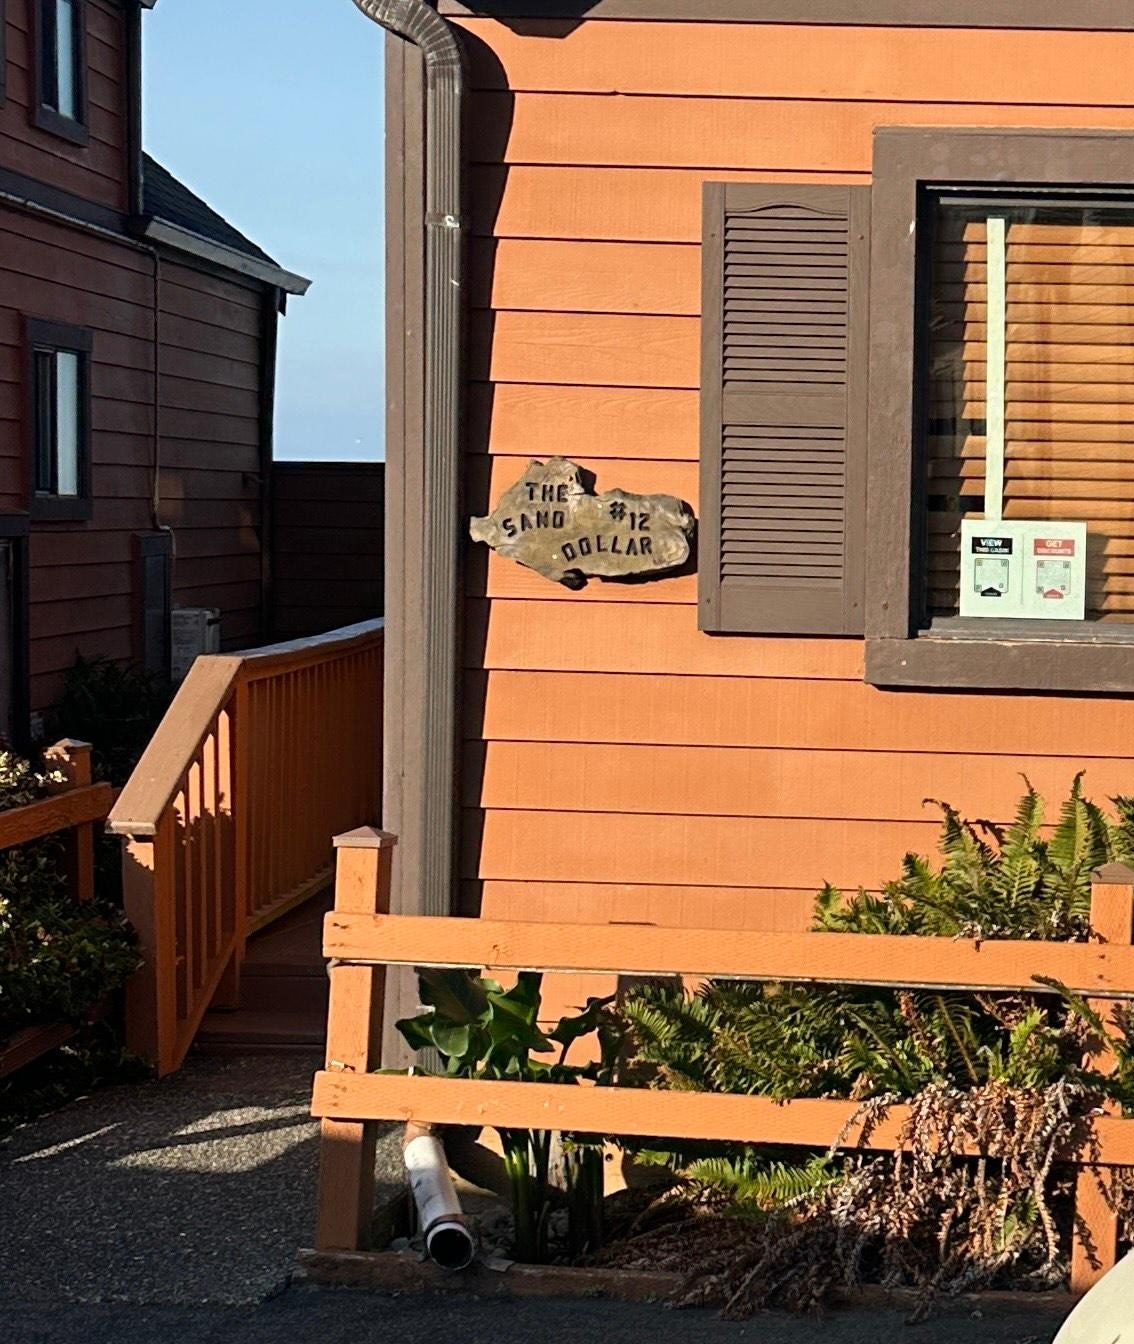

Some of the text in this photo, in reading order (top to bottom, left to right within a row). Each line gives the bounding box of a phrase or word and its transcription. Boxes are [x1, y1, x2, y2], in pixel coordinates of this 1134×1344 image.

[525, 482, 569, 503] THE
[502, 510, 565, 537] SAND
[609, 501, 651, 531] #12
[561, 535, 653, 561] DOLLAR
[980, 538, 1003, 546] VIEW
